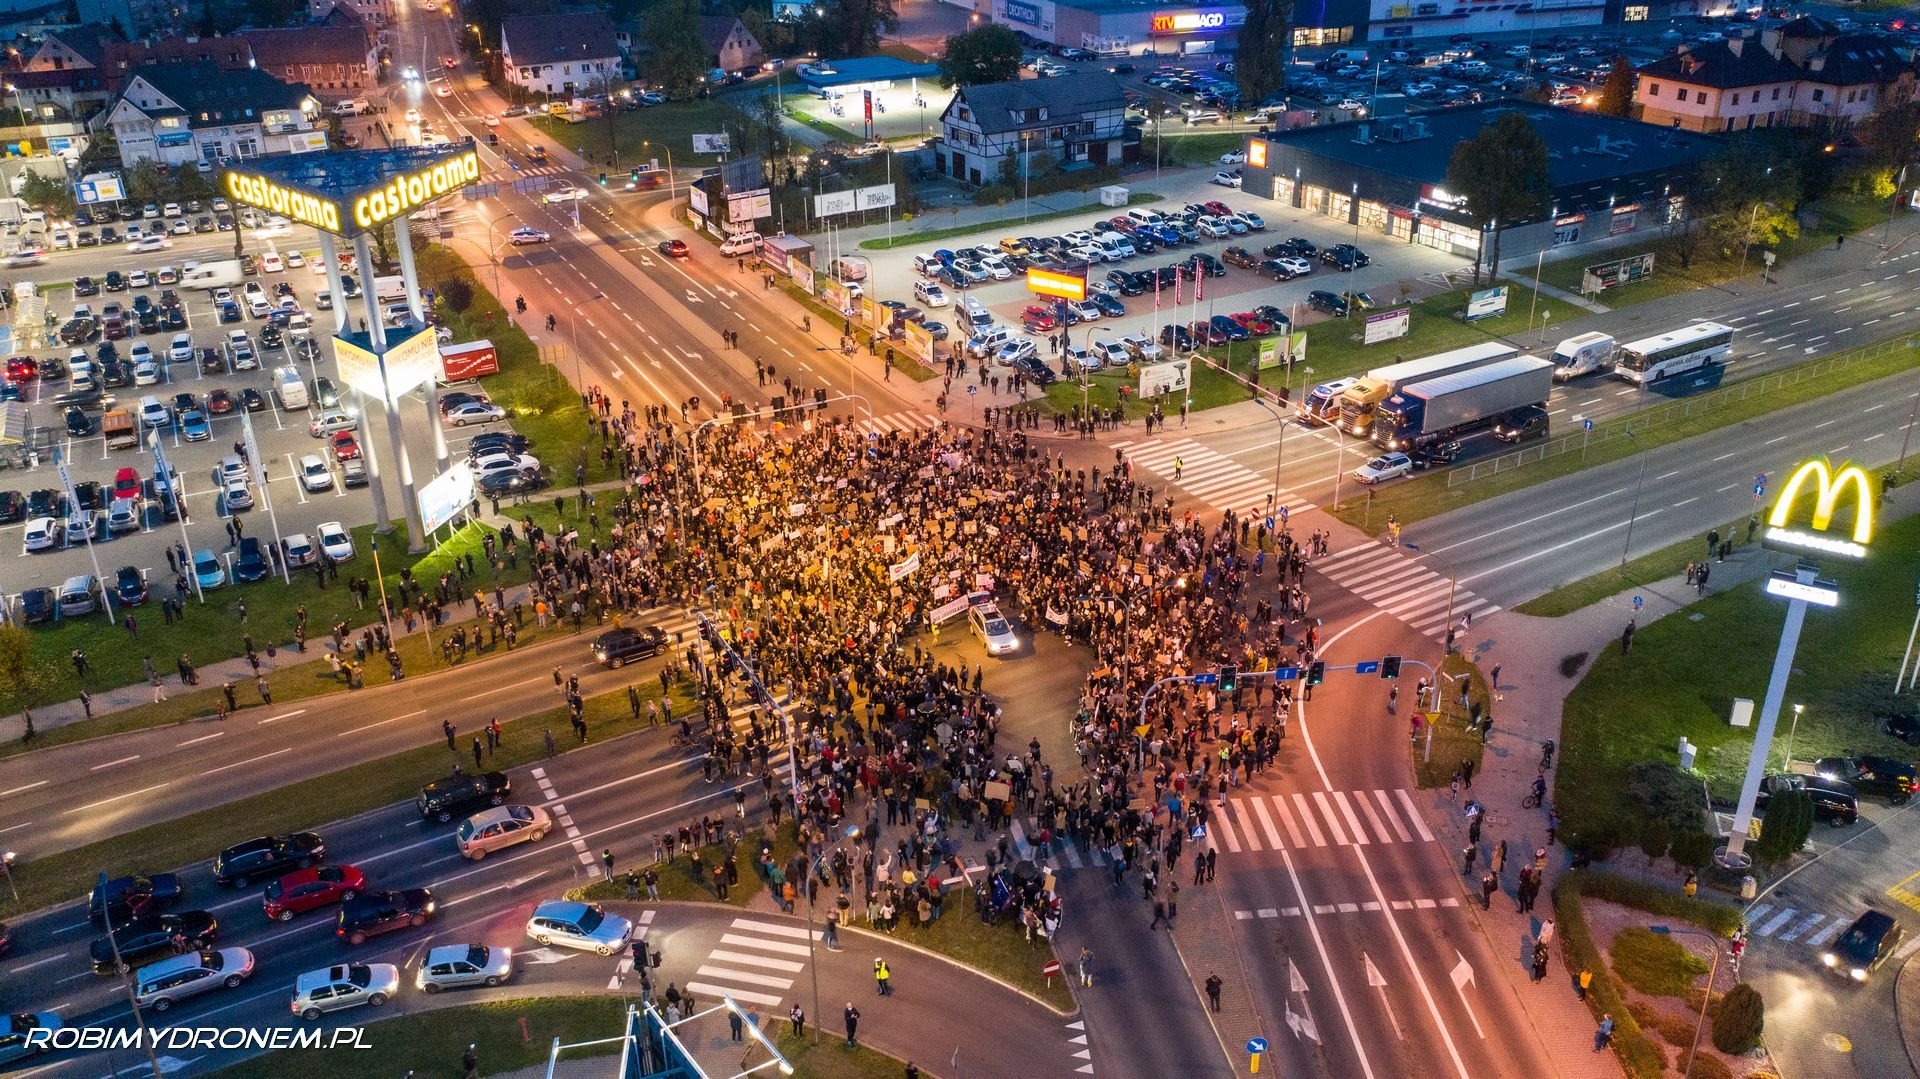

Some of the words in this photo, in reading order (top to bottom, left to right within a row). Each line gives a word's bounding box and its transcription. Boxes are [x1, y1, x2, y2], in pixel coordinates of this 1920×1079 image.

[1154, 16, 1175, 31] RTV
[1199, 13, 1224, 27] AGD
[228, 172, 340, 231] castorama
[355, 152, 478, 227] castorama
[389, 343, 420, 366] NIKOMU
[421, 335, 434, 350] NIE
